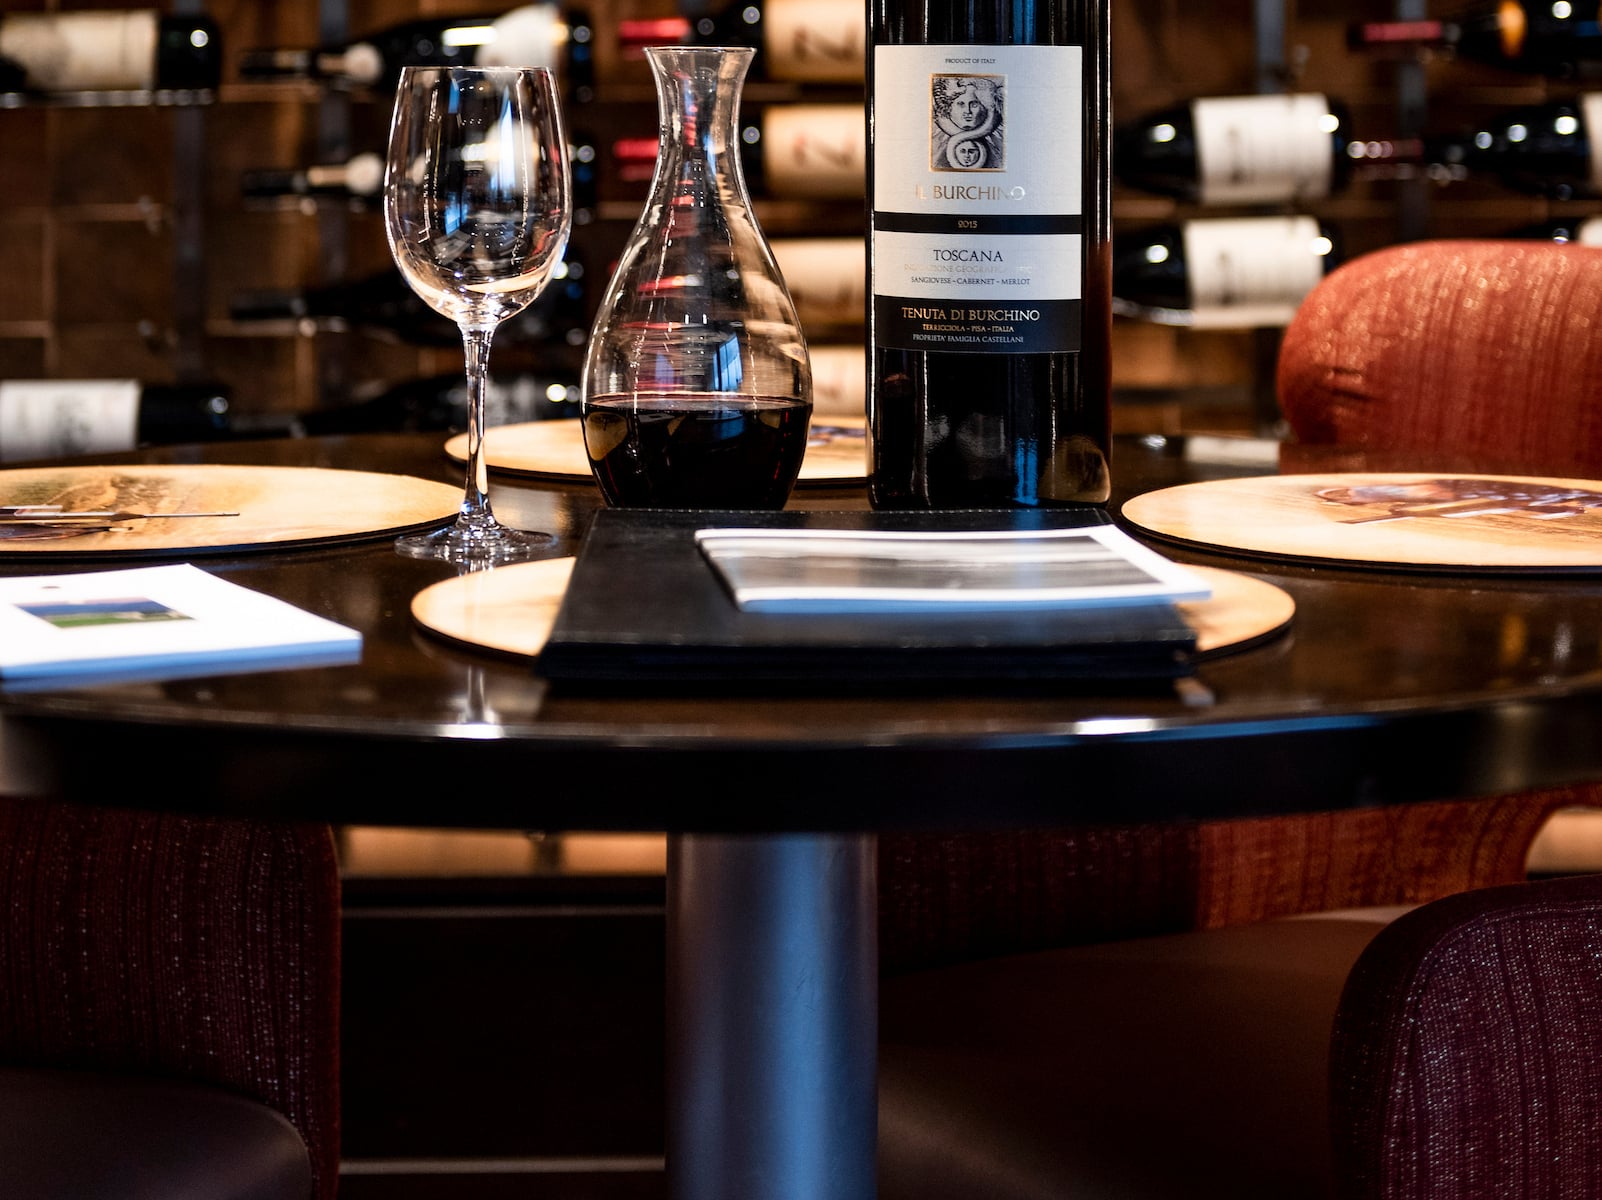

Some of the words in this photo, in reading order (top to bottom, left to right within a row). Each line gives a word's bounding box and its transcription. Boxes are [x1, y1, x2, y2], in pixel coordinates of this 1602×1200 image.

[915, 184, 928, 200] IL
[933, 185, 1026, 201] BURCHINO
[933, 249, 1004, 262] TOSCANA
[911, 276, 952, 285] SANGIOVESE
[956, 277, 995, 286] CABERNET
[1001, 278, 1031, 286] MERLOT
[901, 307, 947, 320] TENUTA
[951, 309, 965, 321] DI
[969, 309, 1041, 321] BURCHINO
[922, 323, 966, 332] TERRICCIOLA
[991, 325, 1015, 333] ITALIA
[947, 334, 981, 343] FAMIGLIA
